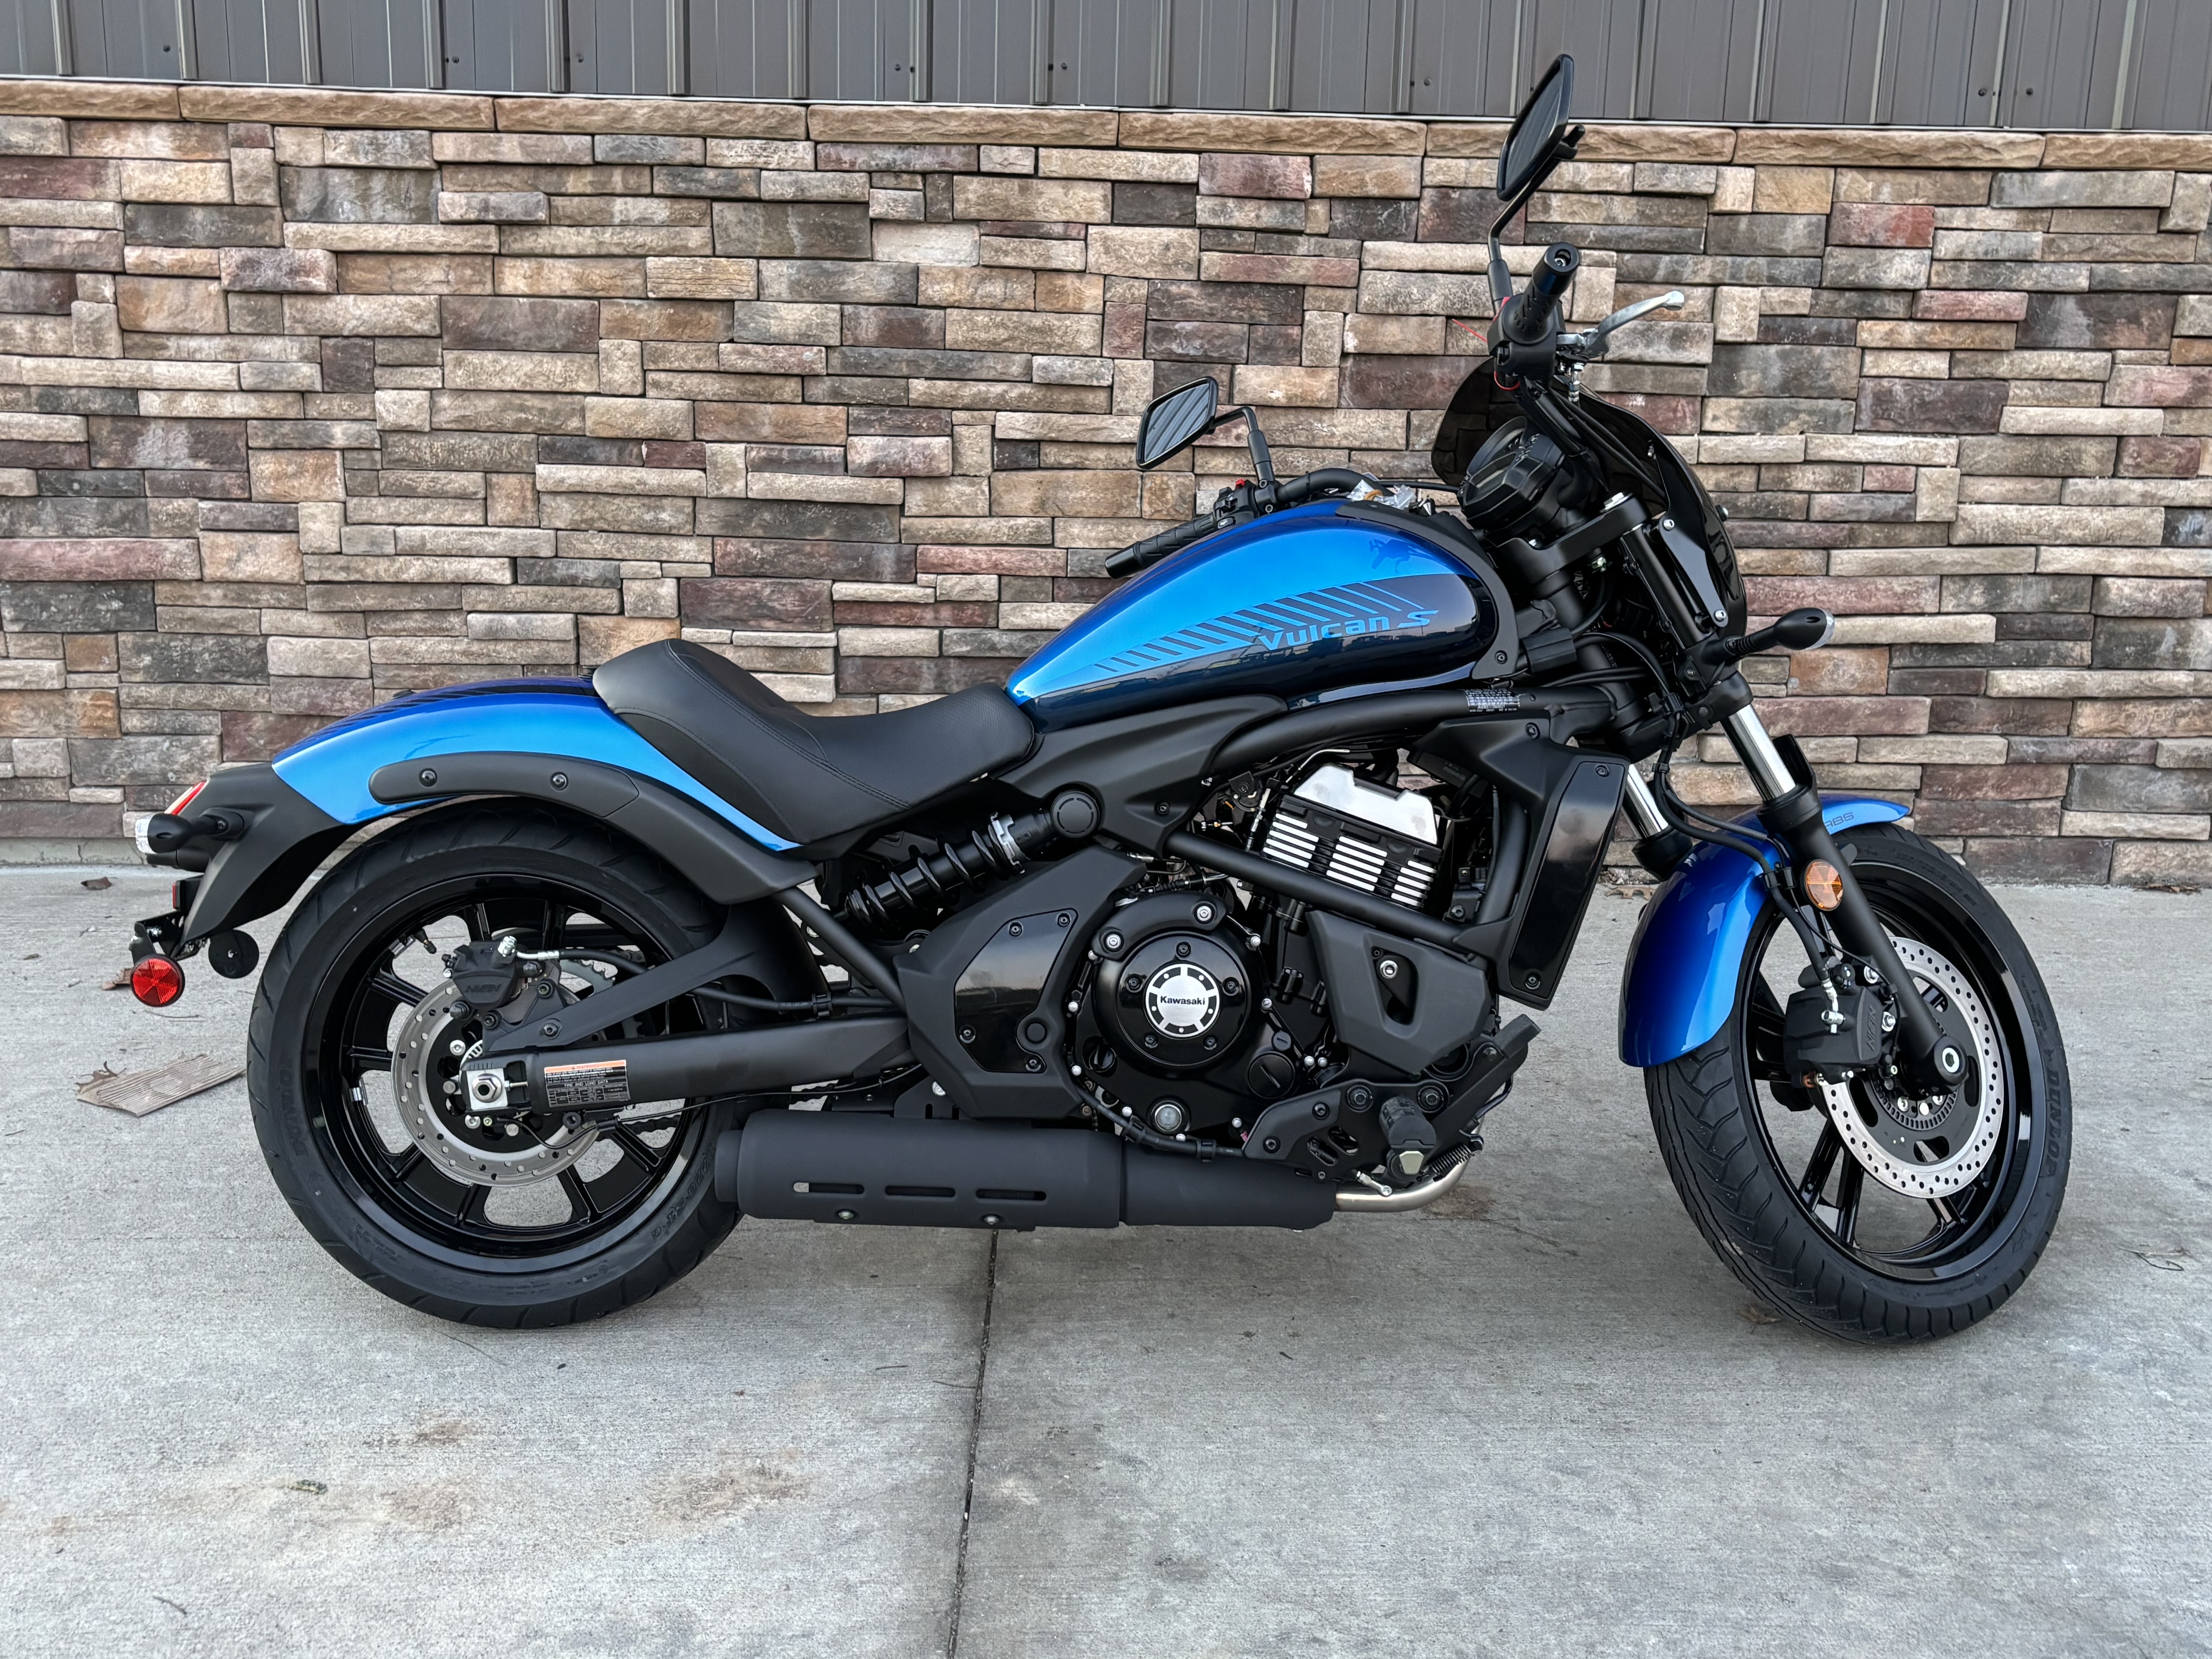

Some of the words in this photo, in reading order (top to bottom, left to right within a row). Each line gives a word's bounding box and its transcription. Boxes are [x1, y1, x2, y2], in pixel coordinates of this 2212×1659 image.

[1258, 616, 1389, 651] Vulcan
[1398, 610, 1439, 628] S
[1824, 812, 1854, 828] ABS
[1160, 995, 1206, 1005] Kawasaki
[2045, 1069, 2061, 1176] DUNLOP
